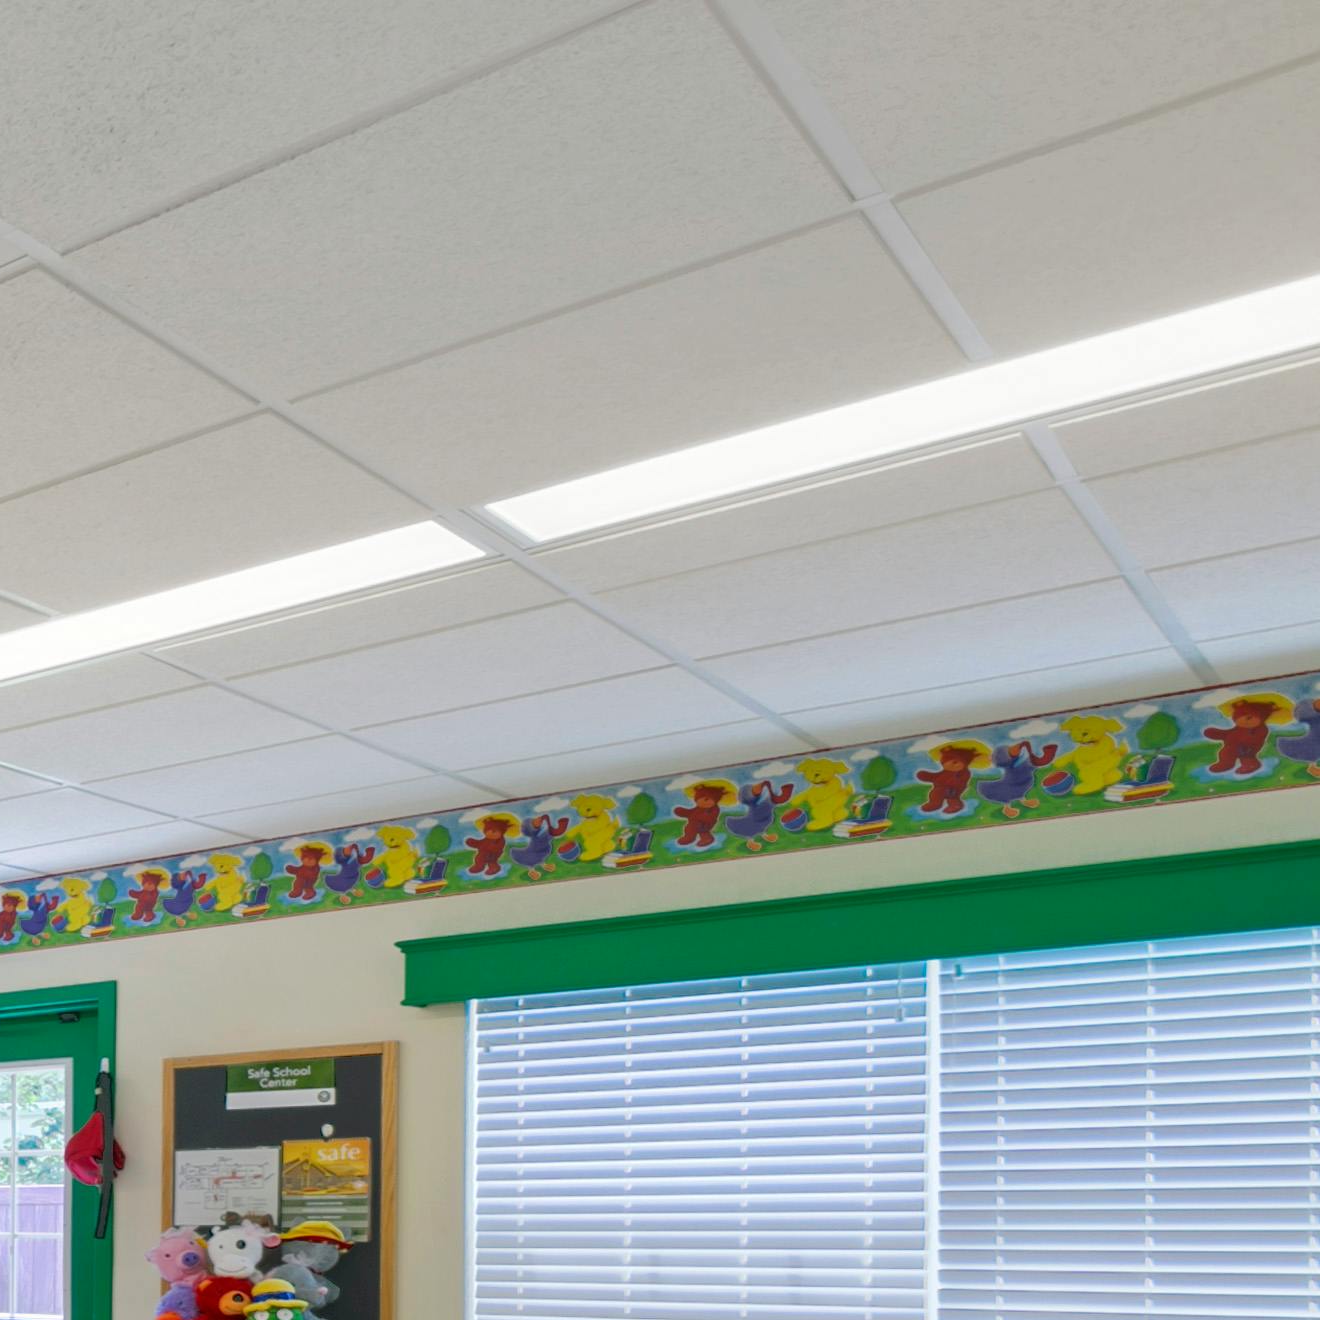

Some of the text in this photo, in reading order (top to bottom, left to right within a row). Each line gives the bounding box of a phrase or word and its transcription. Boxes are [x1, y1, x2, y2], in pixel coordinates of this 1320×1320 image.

[247, 1065, 311, 1079] Safe School
[259, 1078, 298, 1089] Center
[316, 1143, 361, 1161] safe
